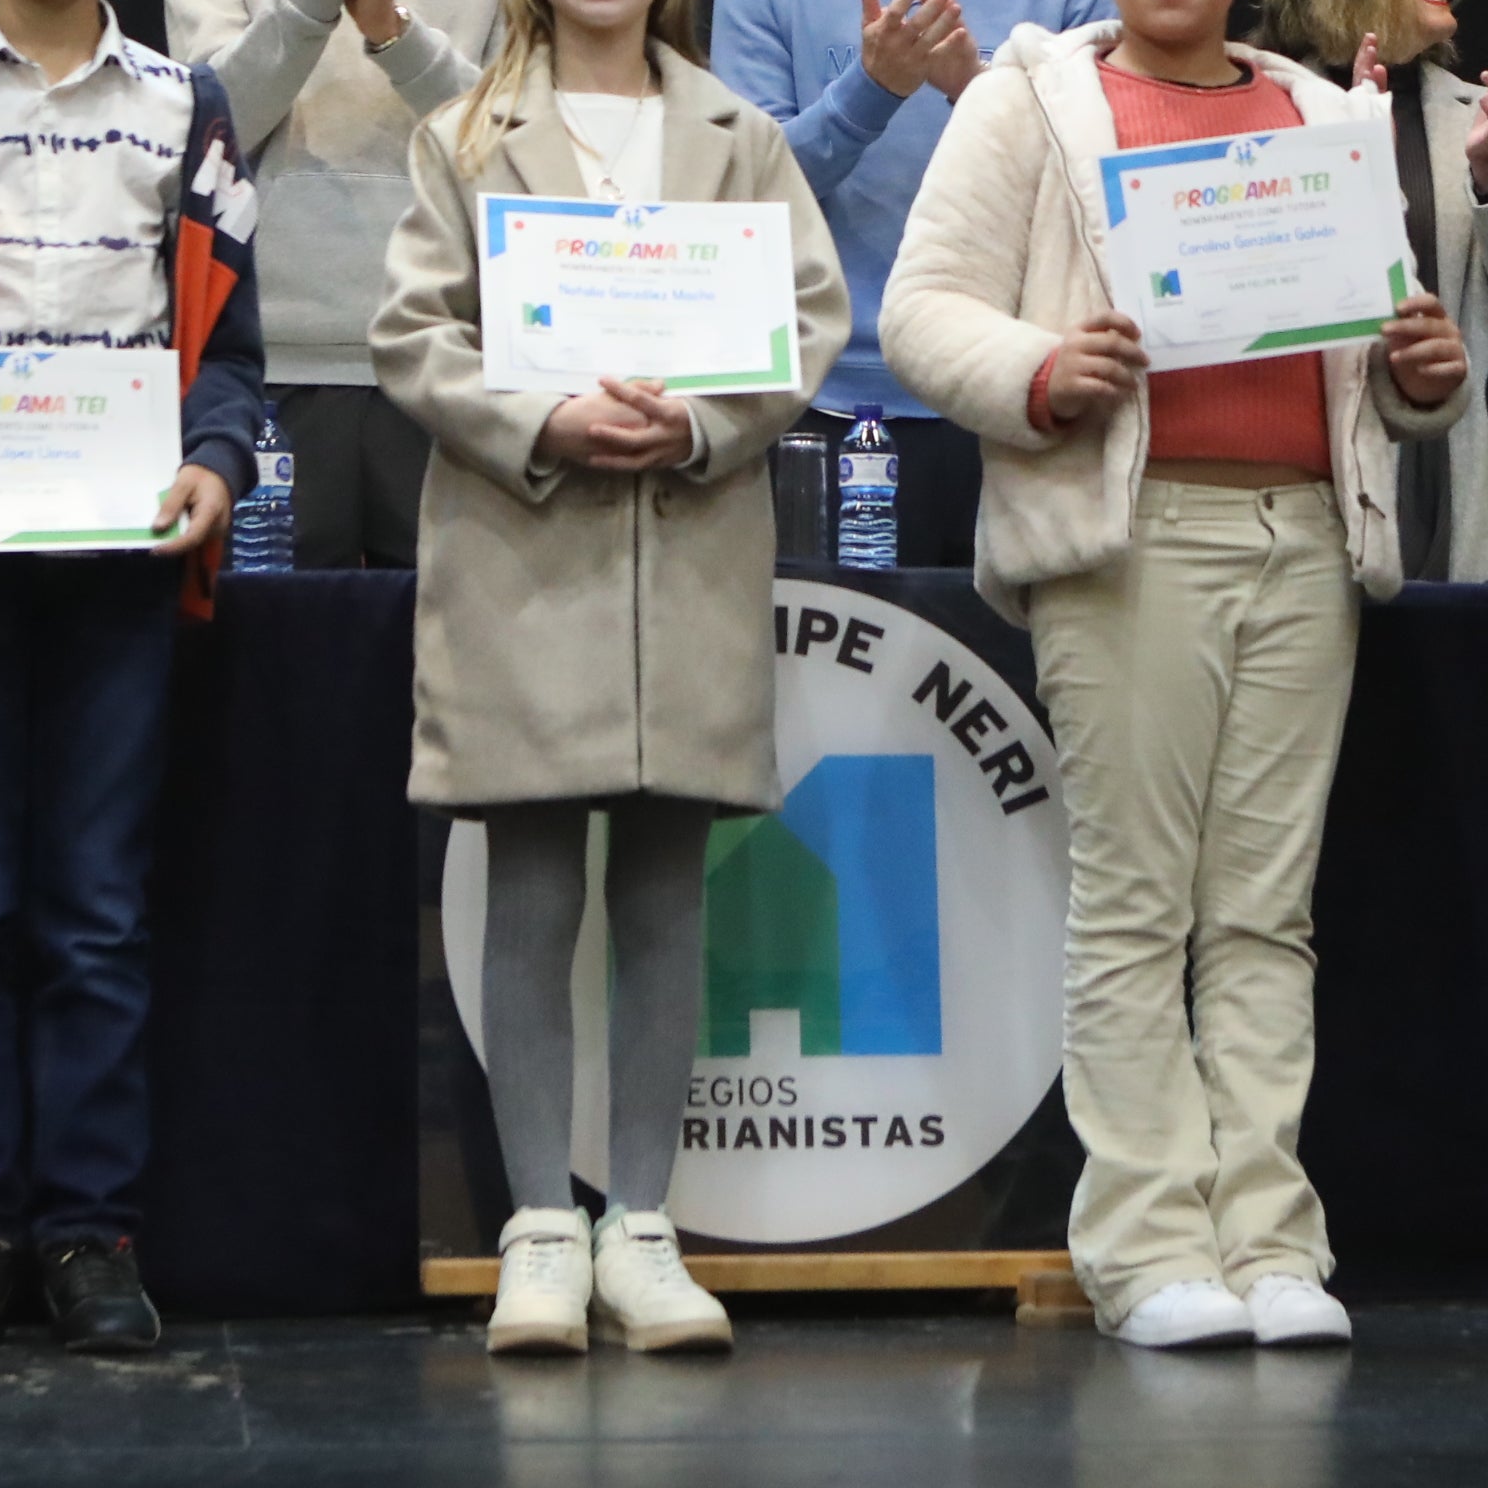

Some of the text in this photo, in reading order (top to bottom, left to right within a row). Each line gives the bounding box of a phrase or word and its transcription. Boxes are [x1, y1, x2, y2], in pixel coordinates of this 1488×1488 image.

[1174, 177, 1291, 211] PROGRAMA
[555, 239, 677, 260] PROGRAMA
[775, 605, 1050, 816] IPE NERI
[688, 1075, 798, 1107] EGIOS
[683, 1114, 945, 1150] RIANISTAS
